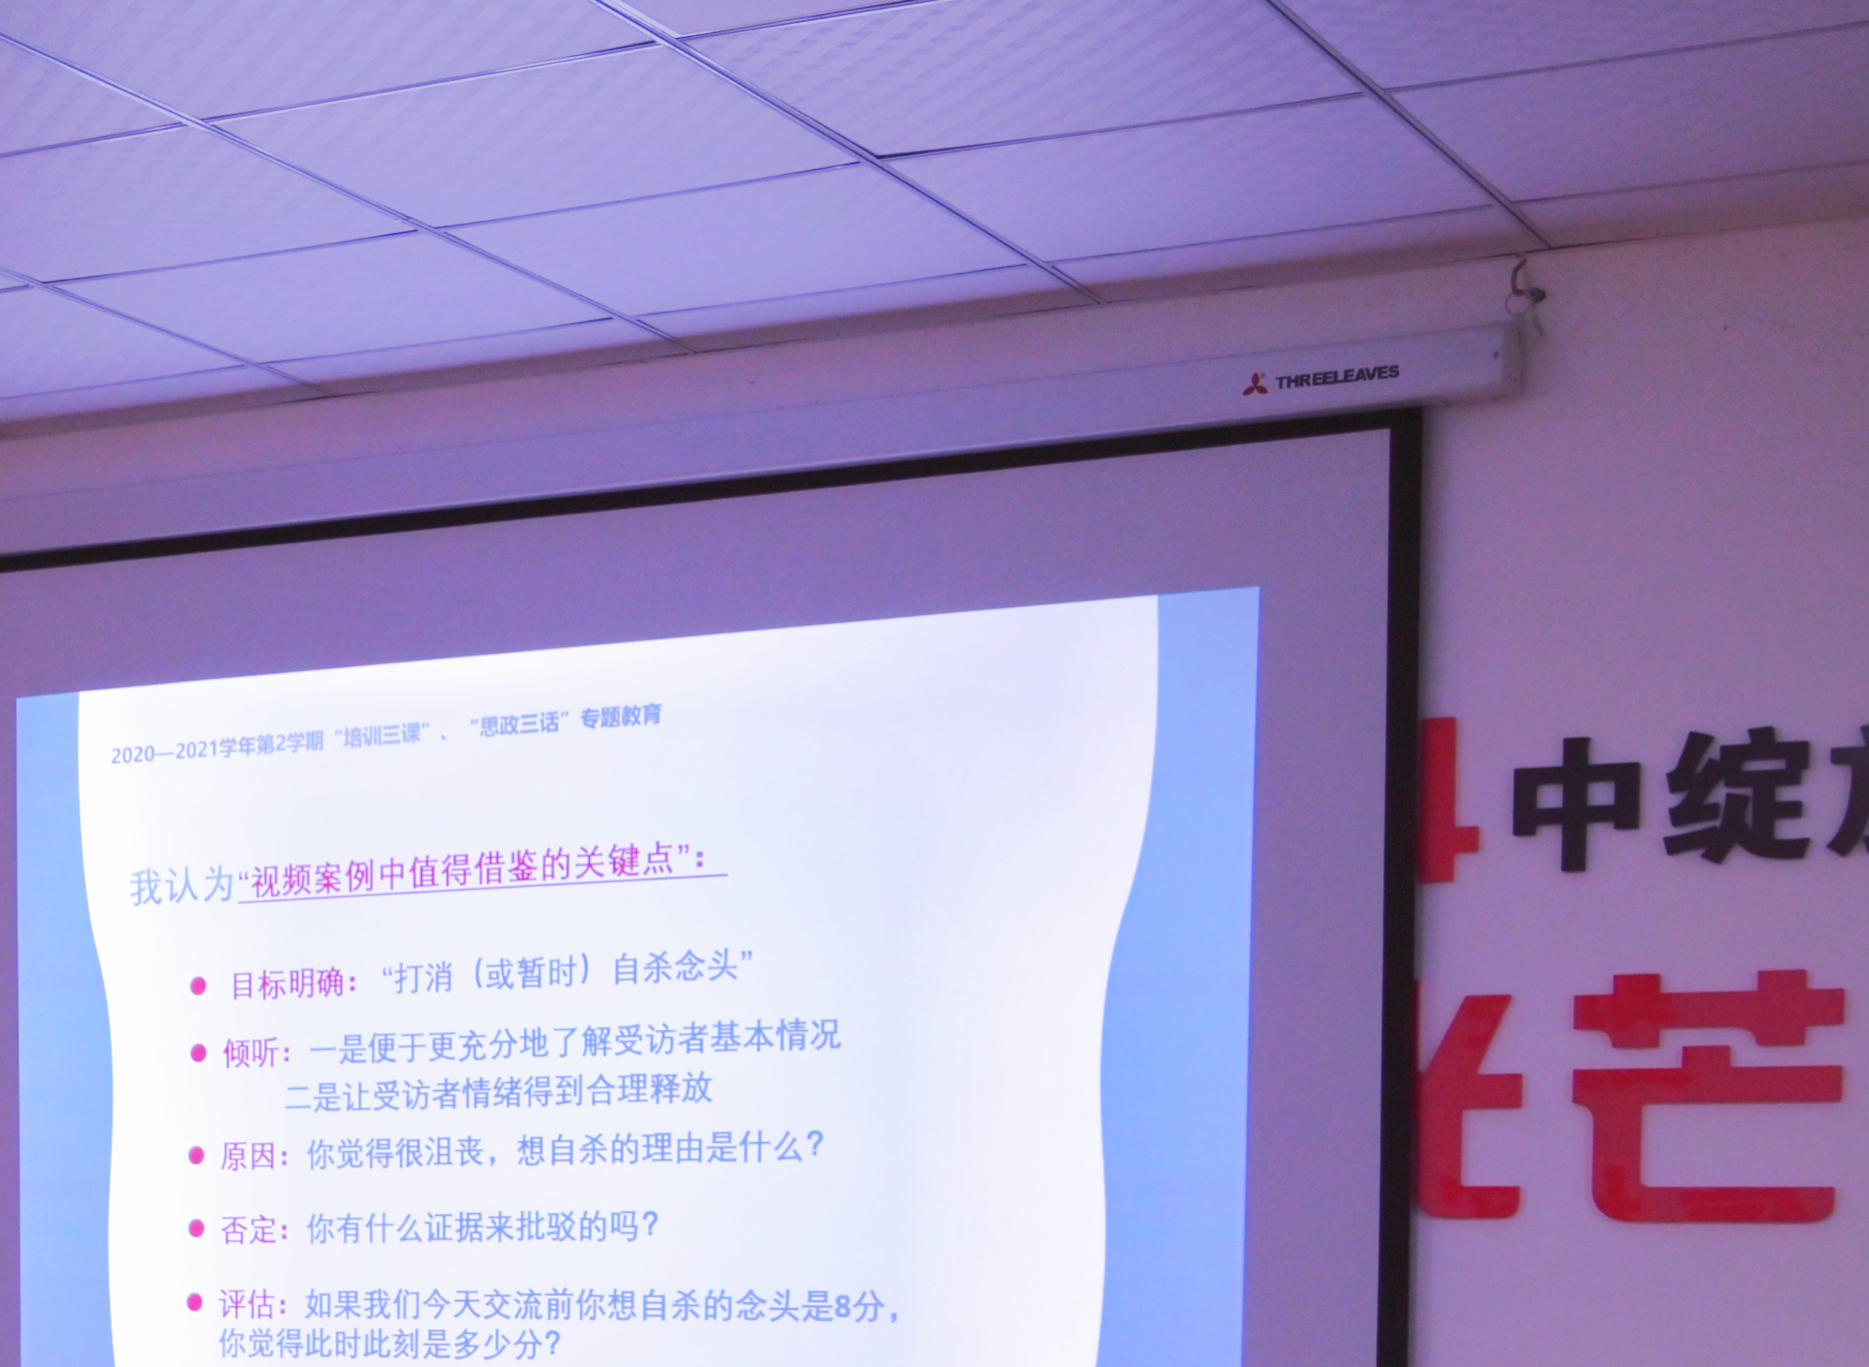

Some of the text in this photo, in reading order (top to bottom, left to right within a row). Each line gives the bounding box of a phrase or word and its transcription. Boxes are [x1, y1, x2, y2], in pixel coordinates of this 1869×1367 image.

[1275, 364, 1401, 390] THREELEAVES
[285, 1071, 713, 1113] 二是让受访者情绪得到合理释放
[218, 1327, 561, 1361] 你觉得此时此刻是多少分？
